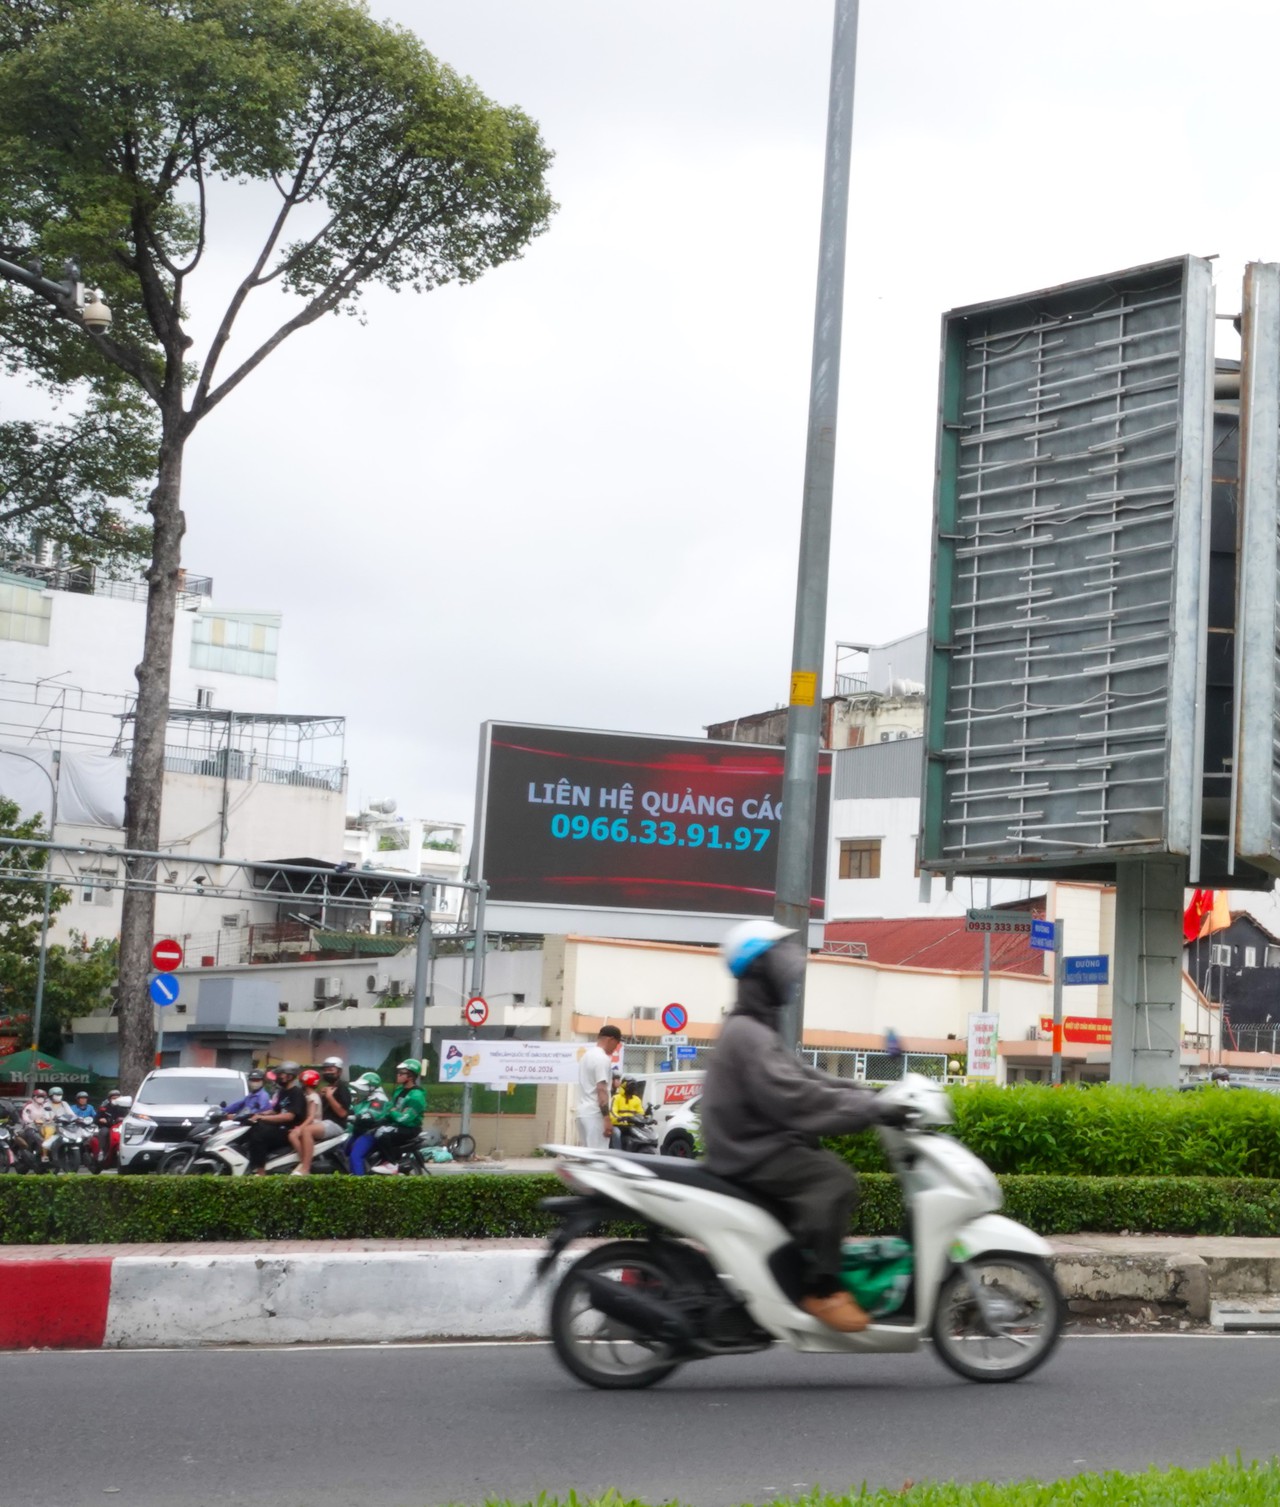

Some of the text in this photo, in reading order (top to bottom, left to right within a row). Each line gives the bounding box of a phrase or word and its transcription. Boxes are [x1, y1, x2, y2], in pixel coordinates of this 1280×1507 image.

[527, 778, 590, 808] LIÊN
[600, 783, 633, 815] HỆ
[641, 787, 734, 818] QUẢNG
[551, 813, 771, 852] 0966.33.91.97
[969, 921, 1032, 932] 0933 333 833
